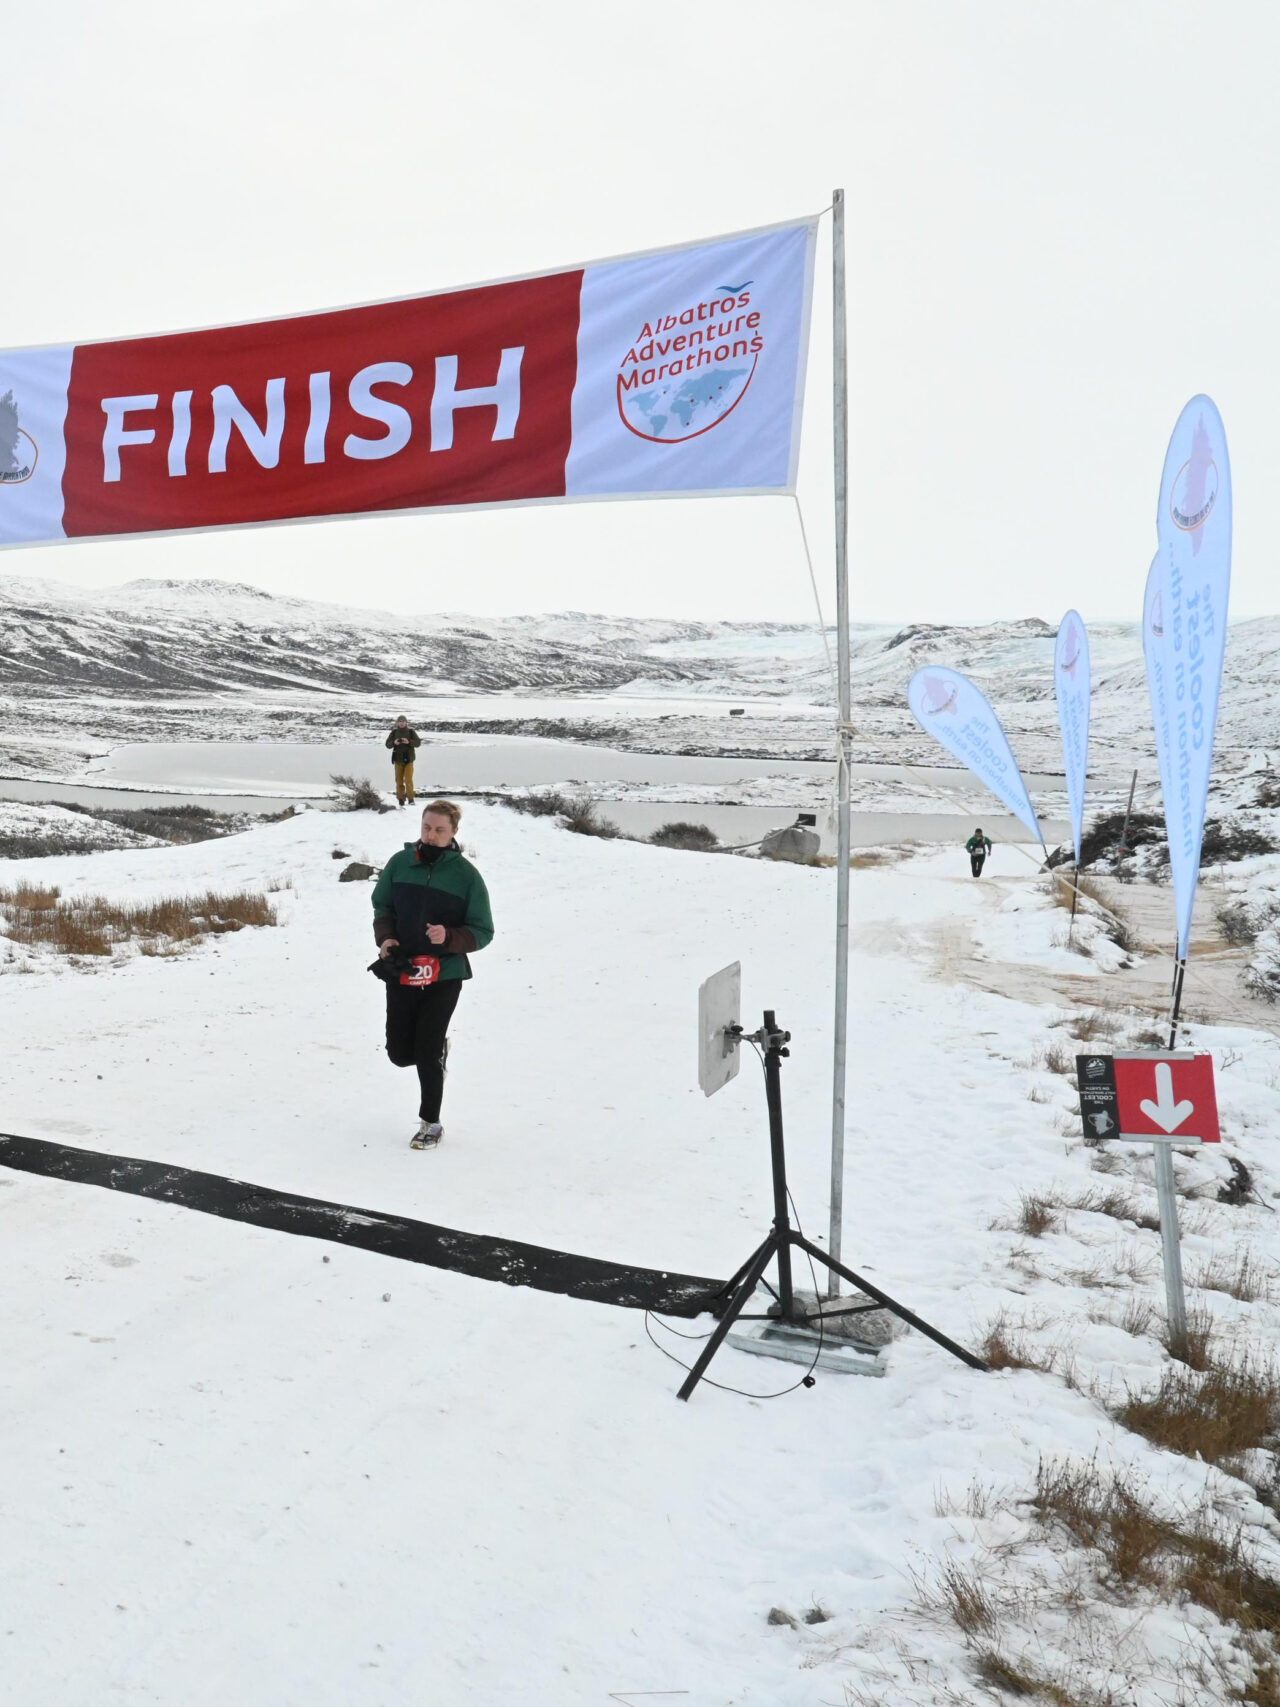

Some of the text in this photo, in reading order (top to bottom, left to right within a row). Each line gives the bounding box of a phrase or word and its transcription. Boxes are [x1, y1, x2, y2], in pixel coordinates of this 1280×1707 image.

[621, 312, 761, 367] Adventure
[636, 292, 750, 343] Albatros
[617, 335, 764, 391] Marathons
[100, 345, 525, 484] FINISH
